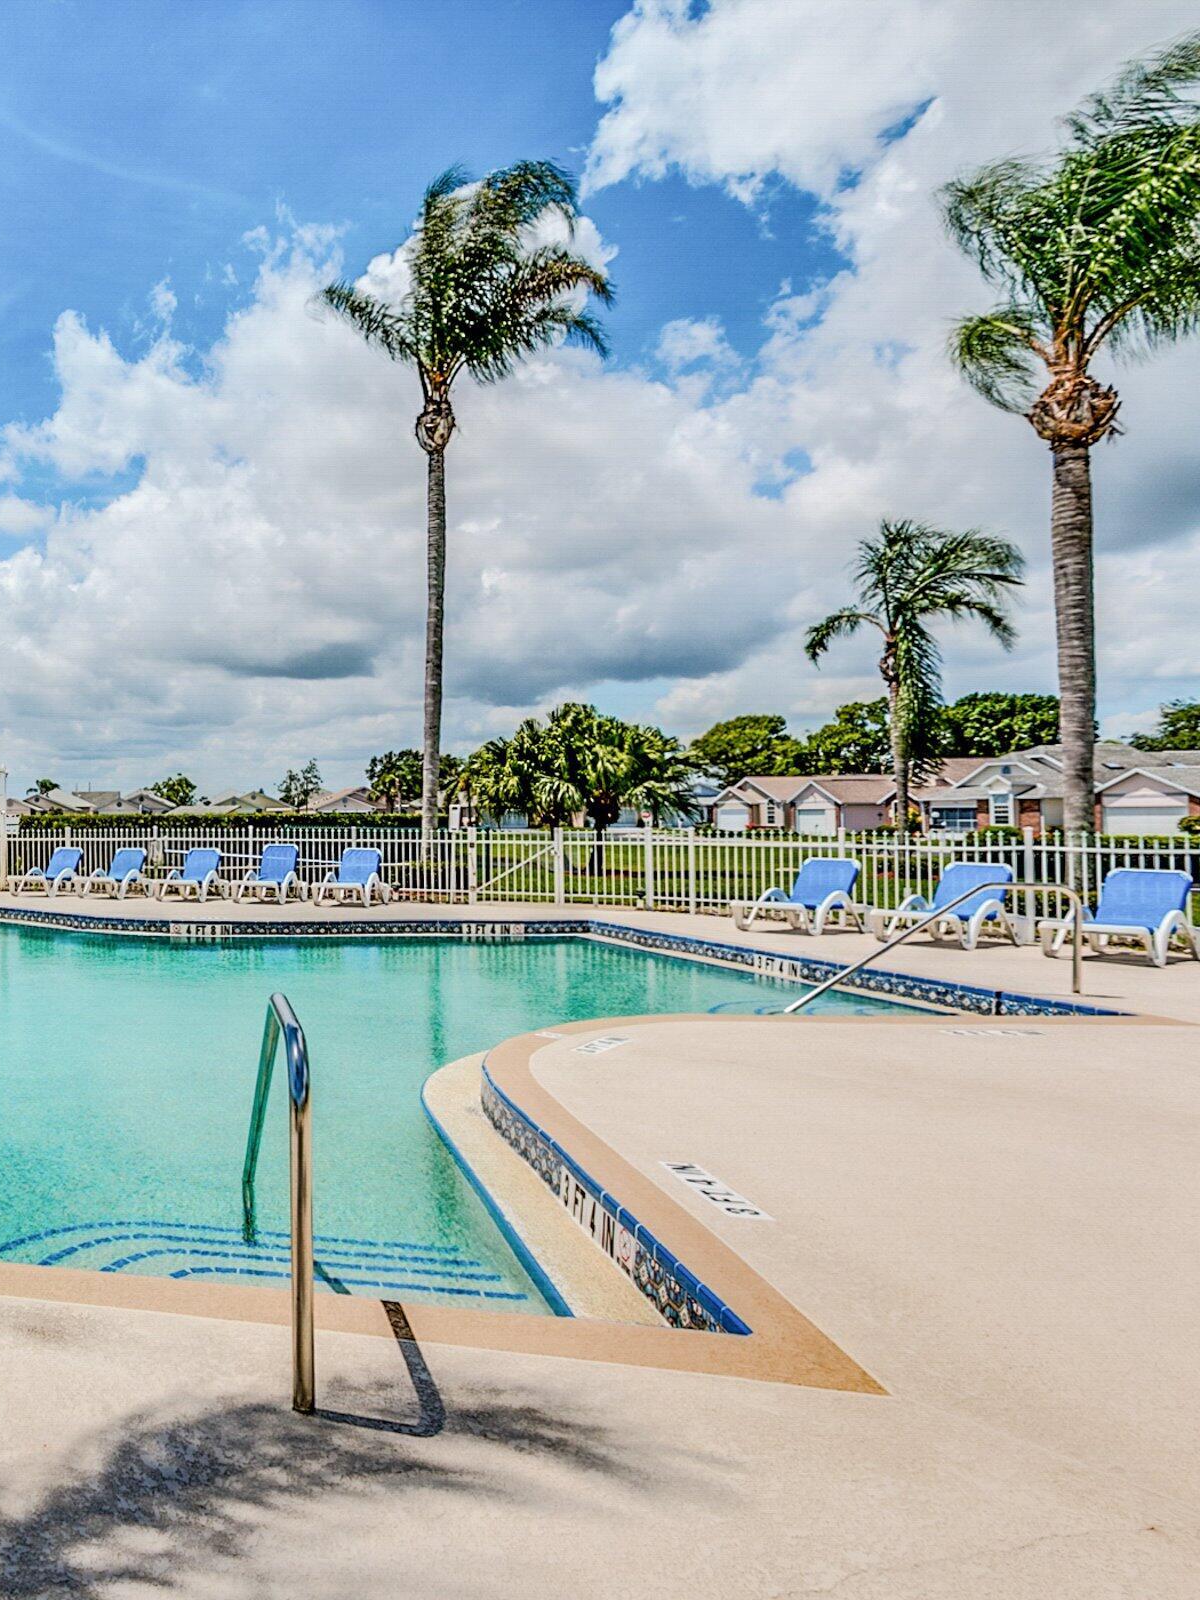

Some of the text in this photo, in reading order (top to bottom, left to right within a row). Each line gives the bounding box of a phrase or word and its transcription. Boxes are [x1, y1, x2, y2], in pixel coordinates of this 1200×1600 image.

[186, 925, 230, 935] 4 FT 8 IN
[466, 924, 471, 934] 3
[475, 924, 486, 934] FT
[500, 924, 510, 934] IN
[765, 957, 775, 972] FT
[787, 961, 798, 977] IN
[563, 1173, 615, 1259] 3 FT 4 IN
[725, 1207, 761, 1216] 3
